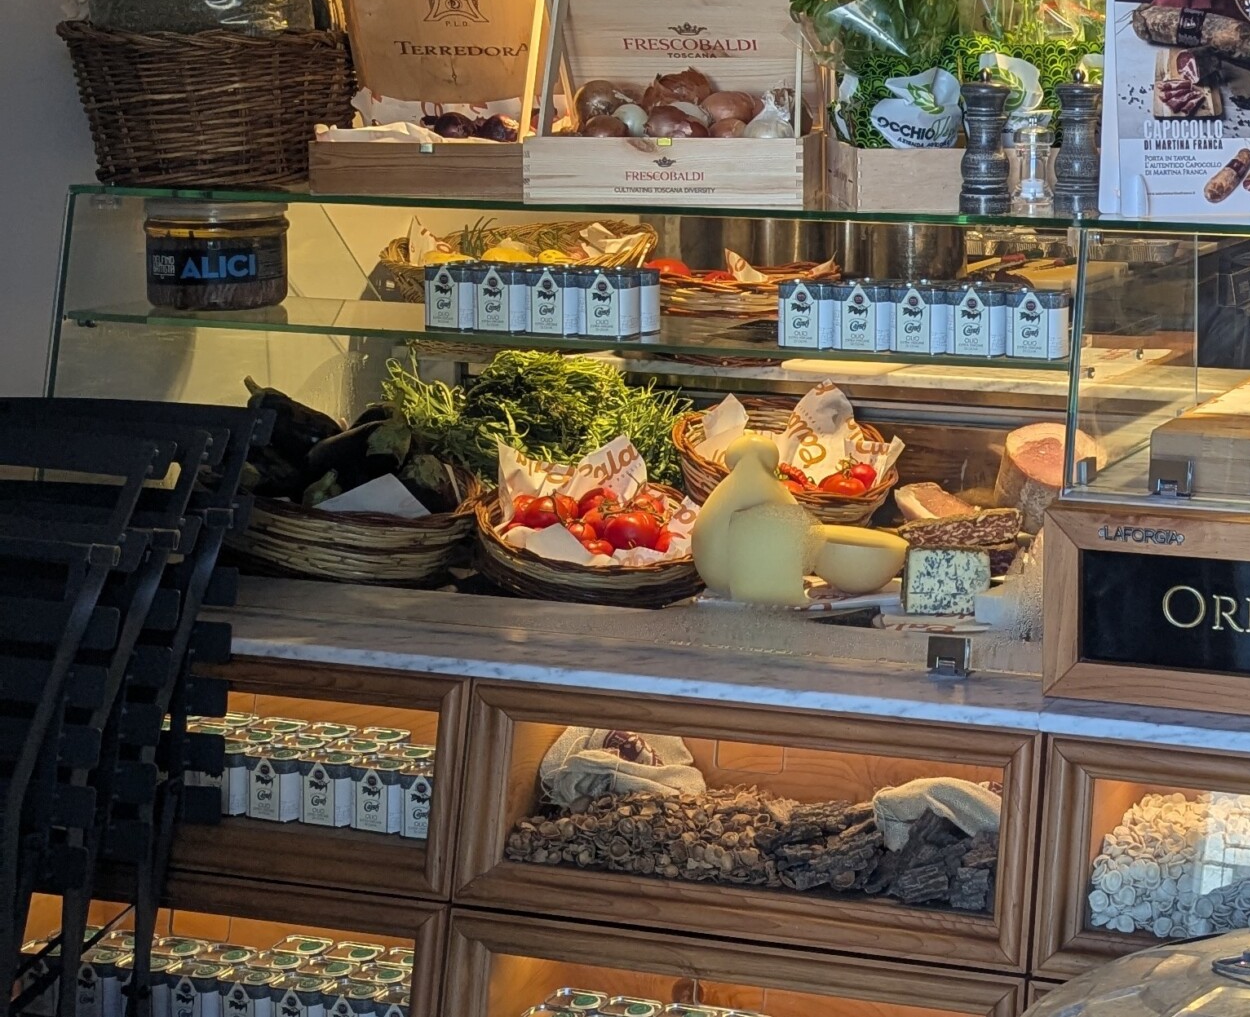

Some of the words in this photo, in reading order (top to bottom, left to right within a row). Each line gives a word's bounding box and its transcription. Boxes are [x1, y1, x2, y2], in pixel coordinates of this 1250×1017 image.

[623, 38, 757, 51] FRESCOBALDI
[877, 116, 935, 140] OCCHIO
[1143, 119, 1223, 139] CAPOCOLLO
[1144, 140, 1152, 150] DI
[1155, 140, 1190, 150] MARTINA
[1193, 140, 1223, 150] FRANCA
[625, 171, 704, 182] FRESCOBALDI
[180, 254, 256, 279] ALICI
[1103, 525, 1179, 545] LAFORGIA
